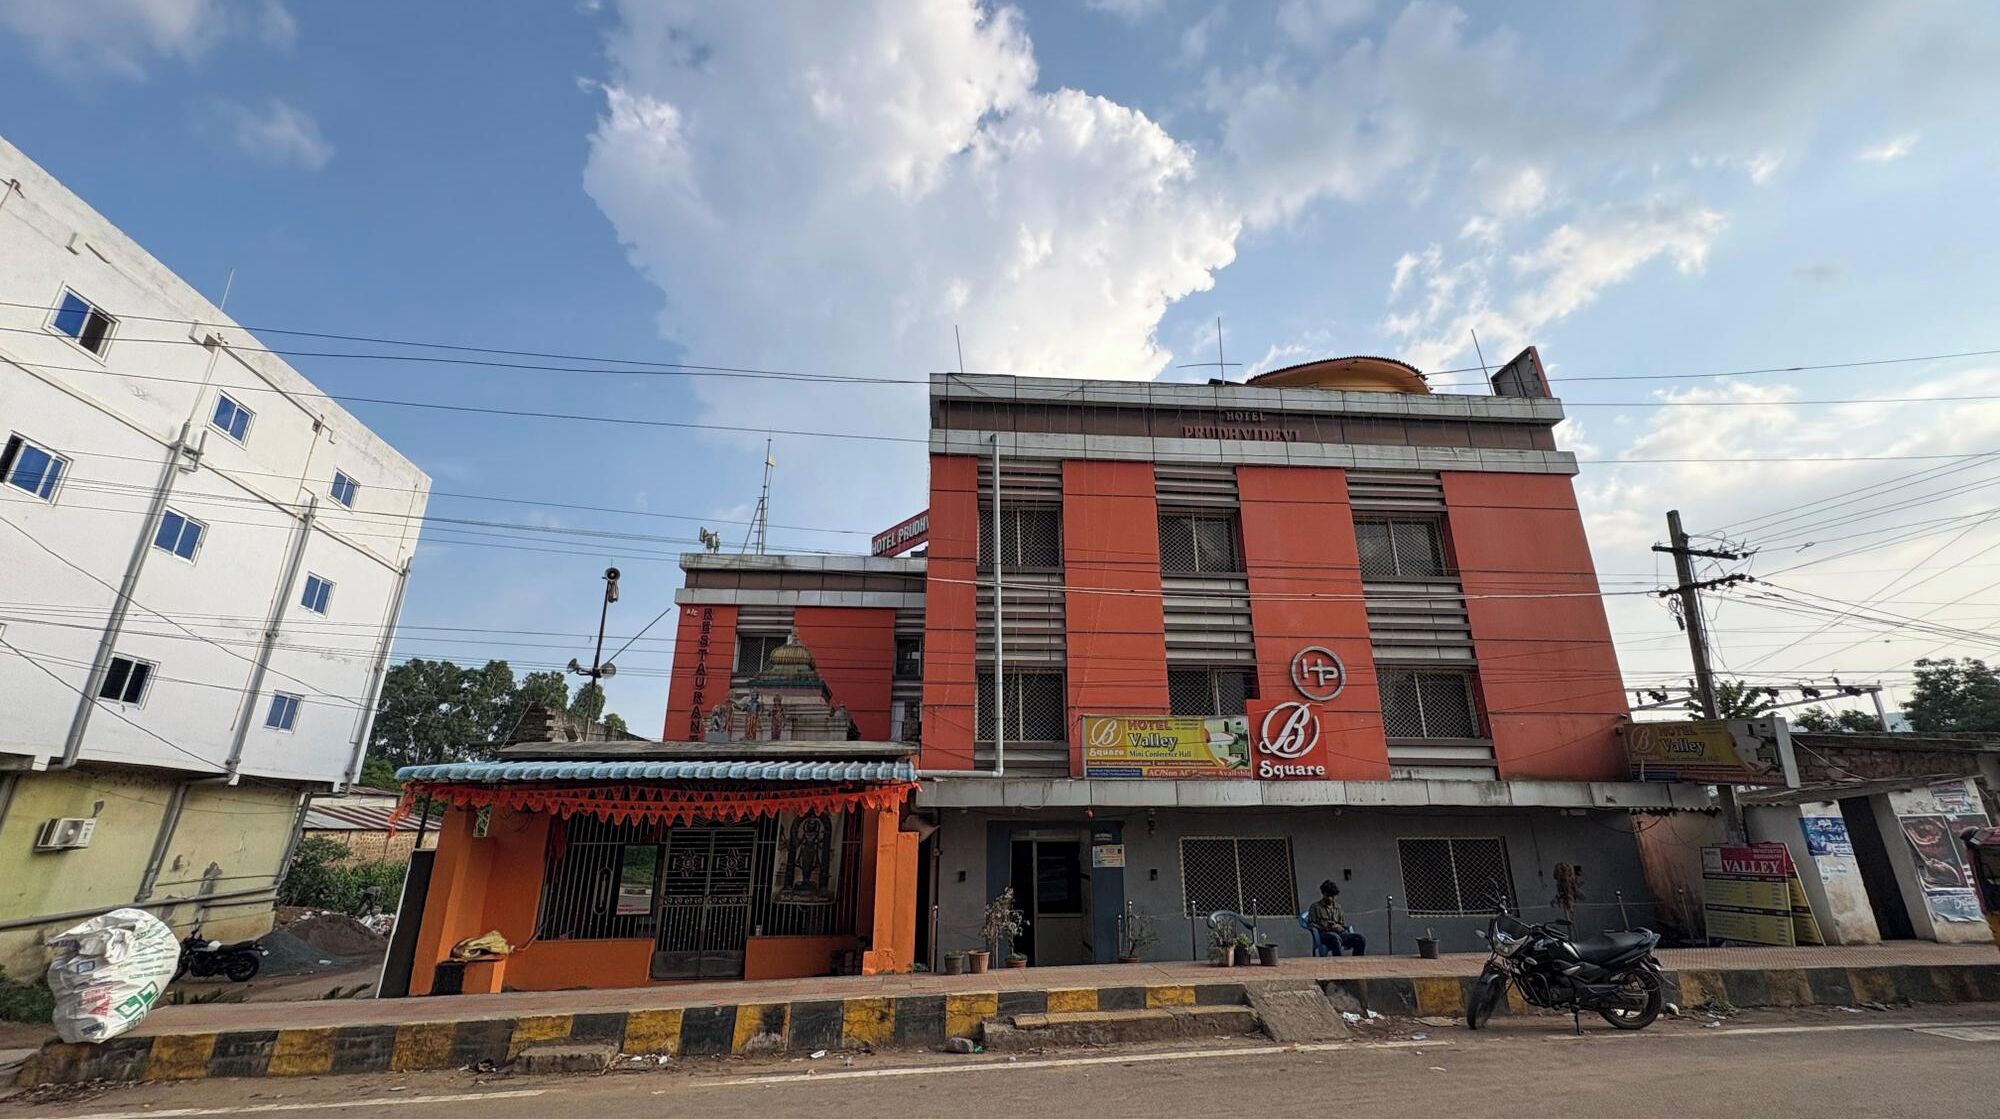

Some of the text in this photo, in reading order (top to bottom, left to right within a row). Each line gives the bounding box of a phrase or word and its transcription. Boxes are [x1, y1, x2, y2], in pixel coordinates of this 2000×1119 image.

[1225, 411, 1266, 422] HOTEL
[872, 533, 897, 555] HOTEL
[1127, 719, 1172, 730] HOTEL
[1128, 732, 1178, 752] Valley
[1661, 738, 1705, 757] Valley
[1089, 748, 1124, 757] Square
[1259, 760, 1325, 778] Square
[1722, 859, 1780, 874] VALLEY
